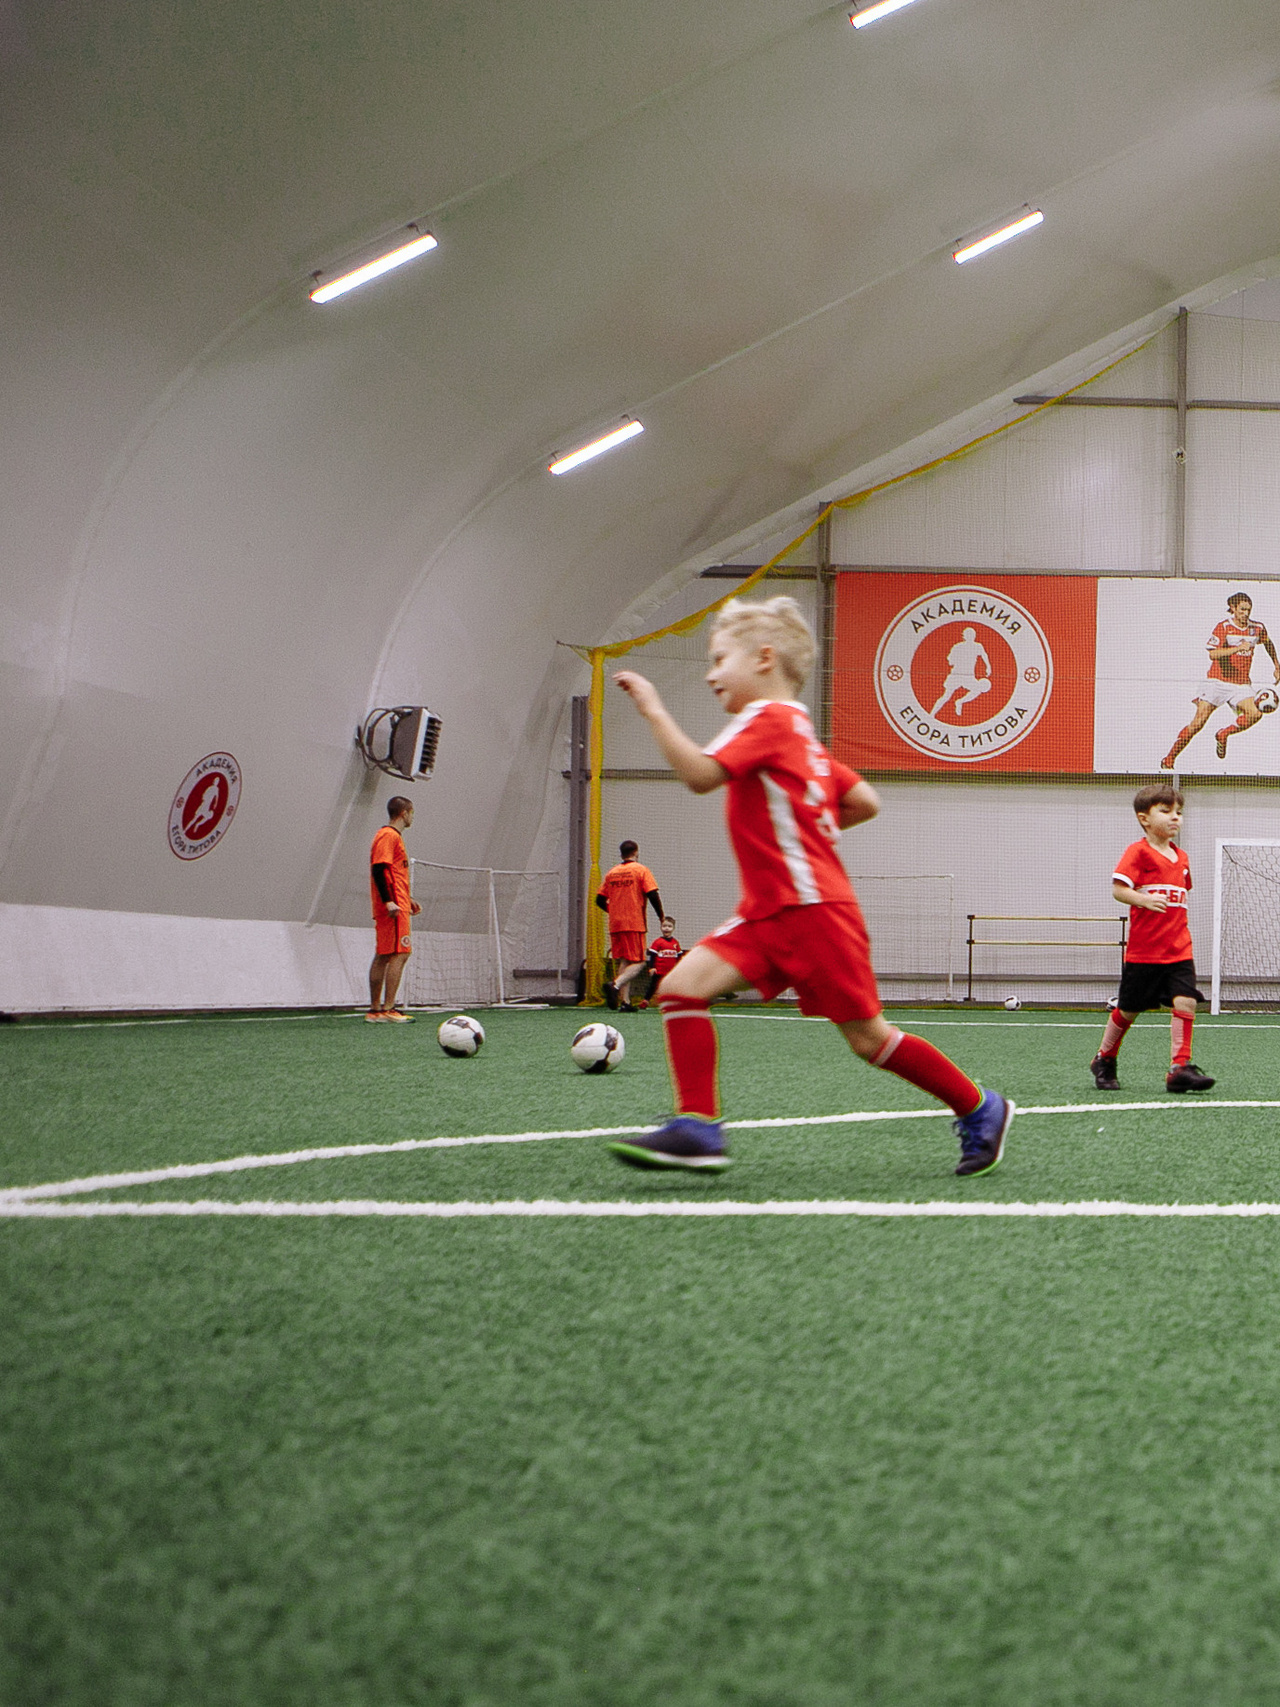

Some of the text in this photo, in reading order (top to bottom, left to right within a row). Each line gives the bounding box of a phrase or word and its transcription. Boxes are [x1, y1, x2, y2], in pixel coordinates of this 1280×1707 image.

[910, 599, 1022, 636] АКАДЕМИЯ
[900, 706, 1028, 748] ЕГОРА ТИТОВА
[195, 758, 238, 784] АКАДЕМИЯ
